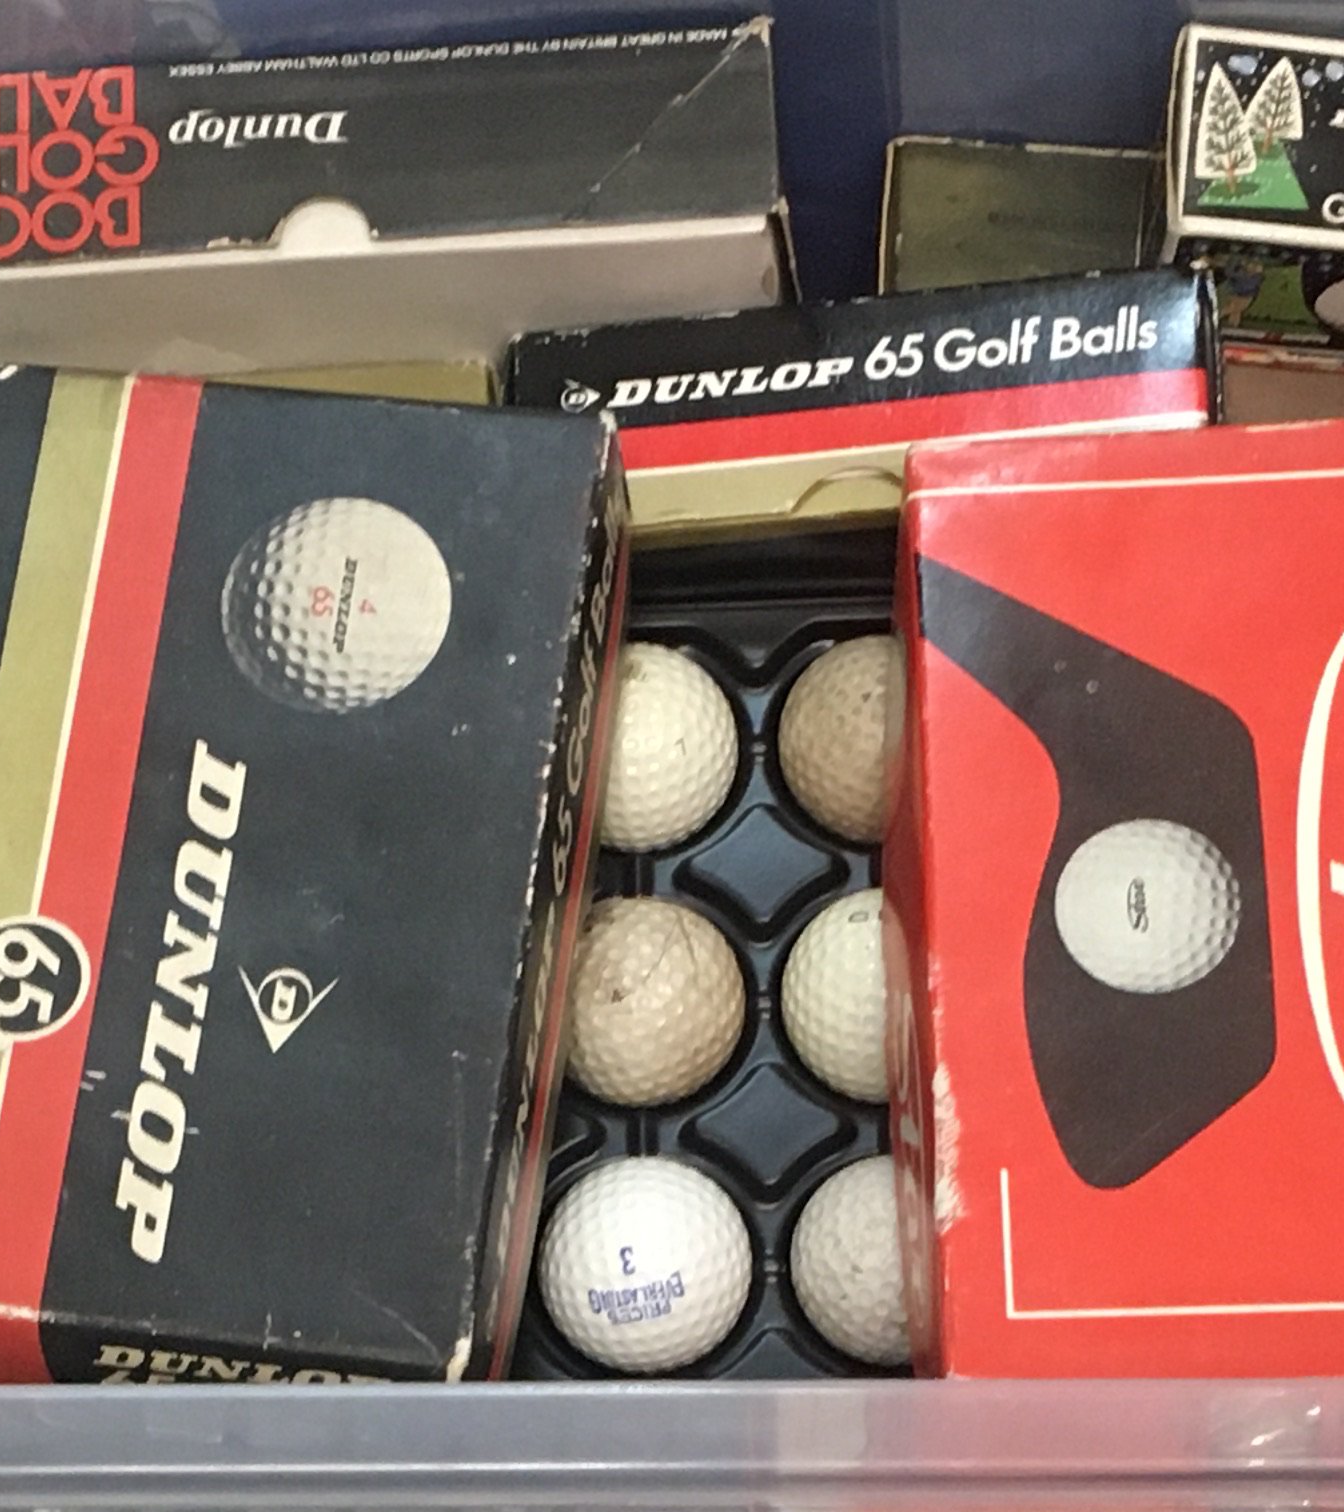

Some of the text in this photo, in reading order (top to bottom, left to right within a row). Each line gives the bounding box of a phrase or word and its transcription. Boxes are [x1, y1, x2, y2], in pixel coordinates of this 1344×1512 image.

[168, 108, 349, 148] Dunlop
[607, 305, 1159, 409] DUNLOP 65 Golf Balls
[311, 586, 334, 617] 65
[332, 555, 358, 654] DUNLOP
[567, 630, 597, 797] Golf
[115, 738, 247, 1264] DUNLOP
[620, 1246, 636, 1276] 3
[93, 1344, 391, 1384] DUNLO
